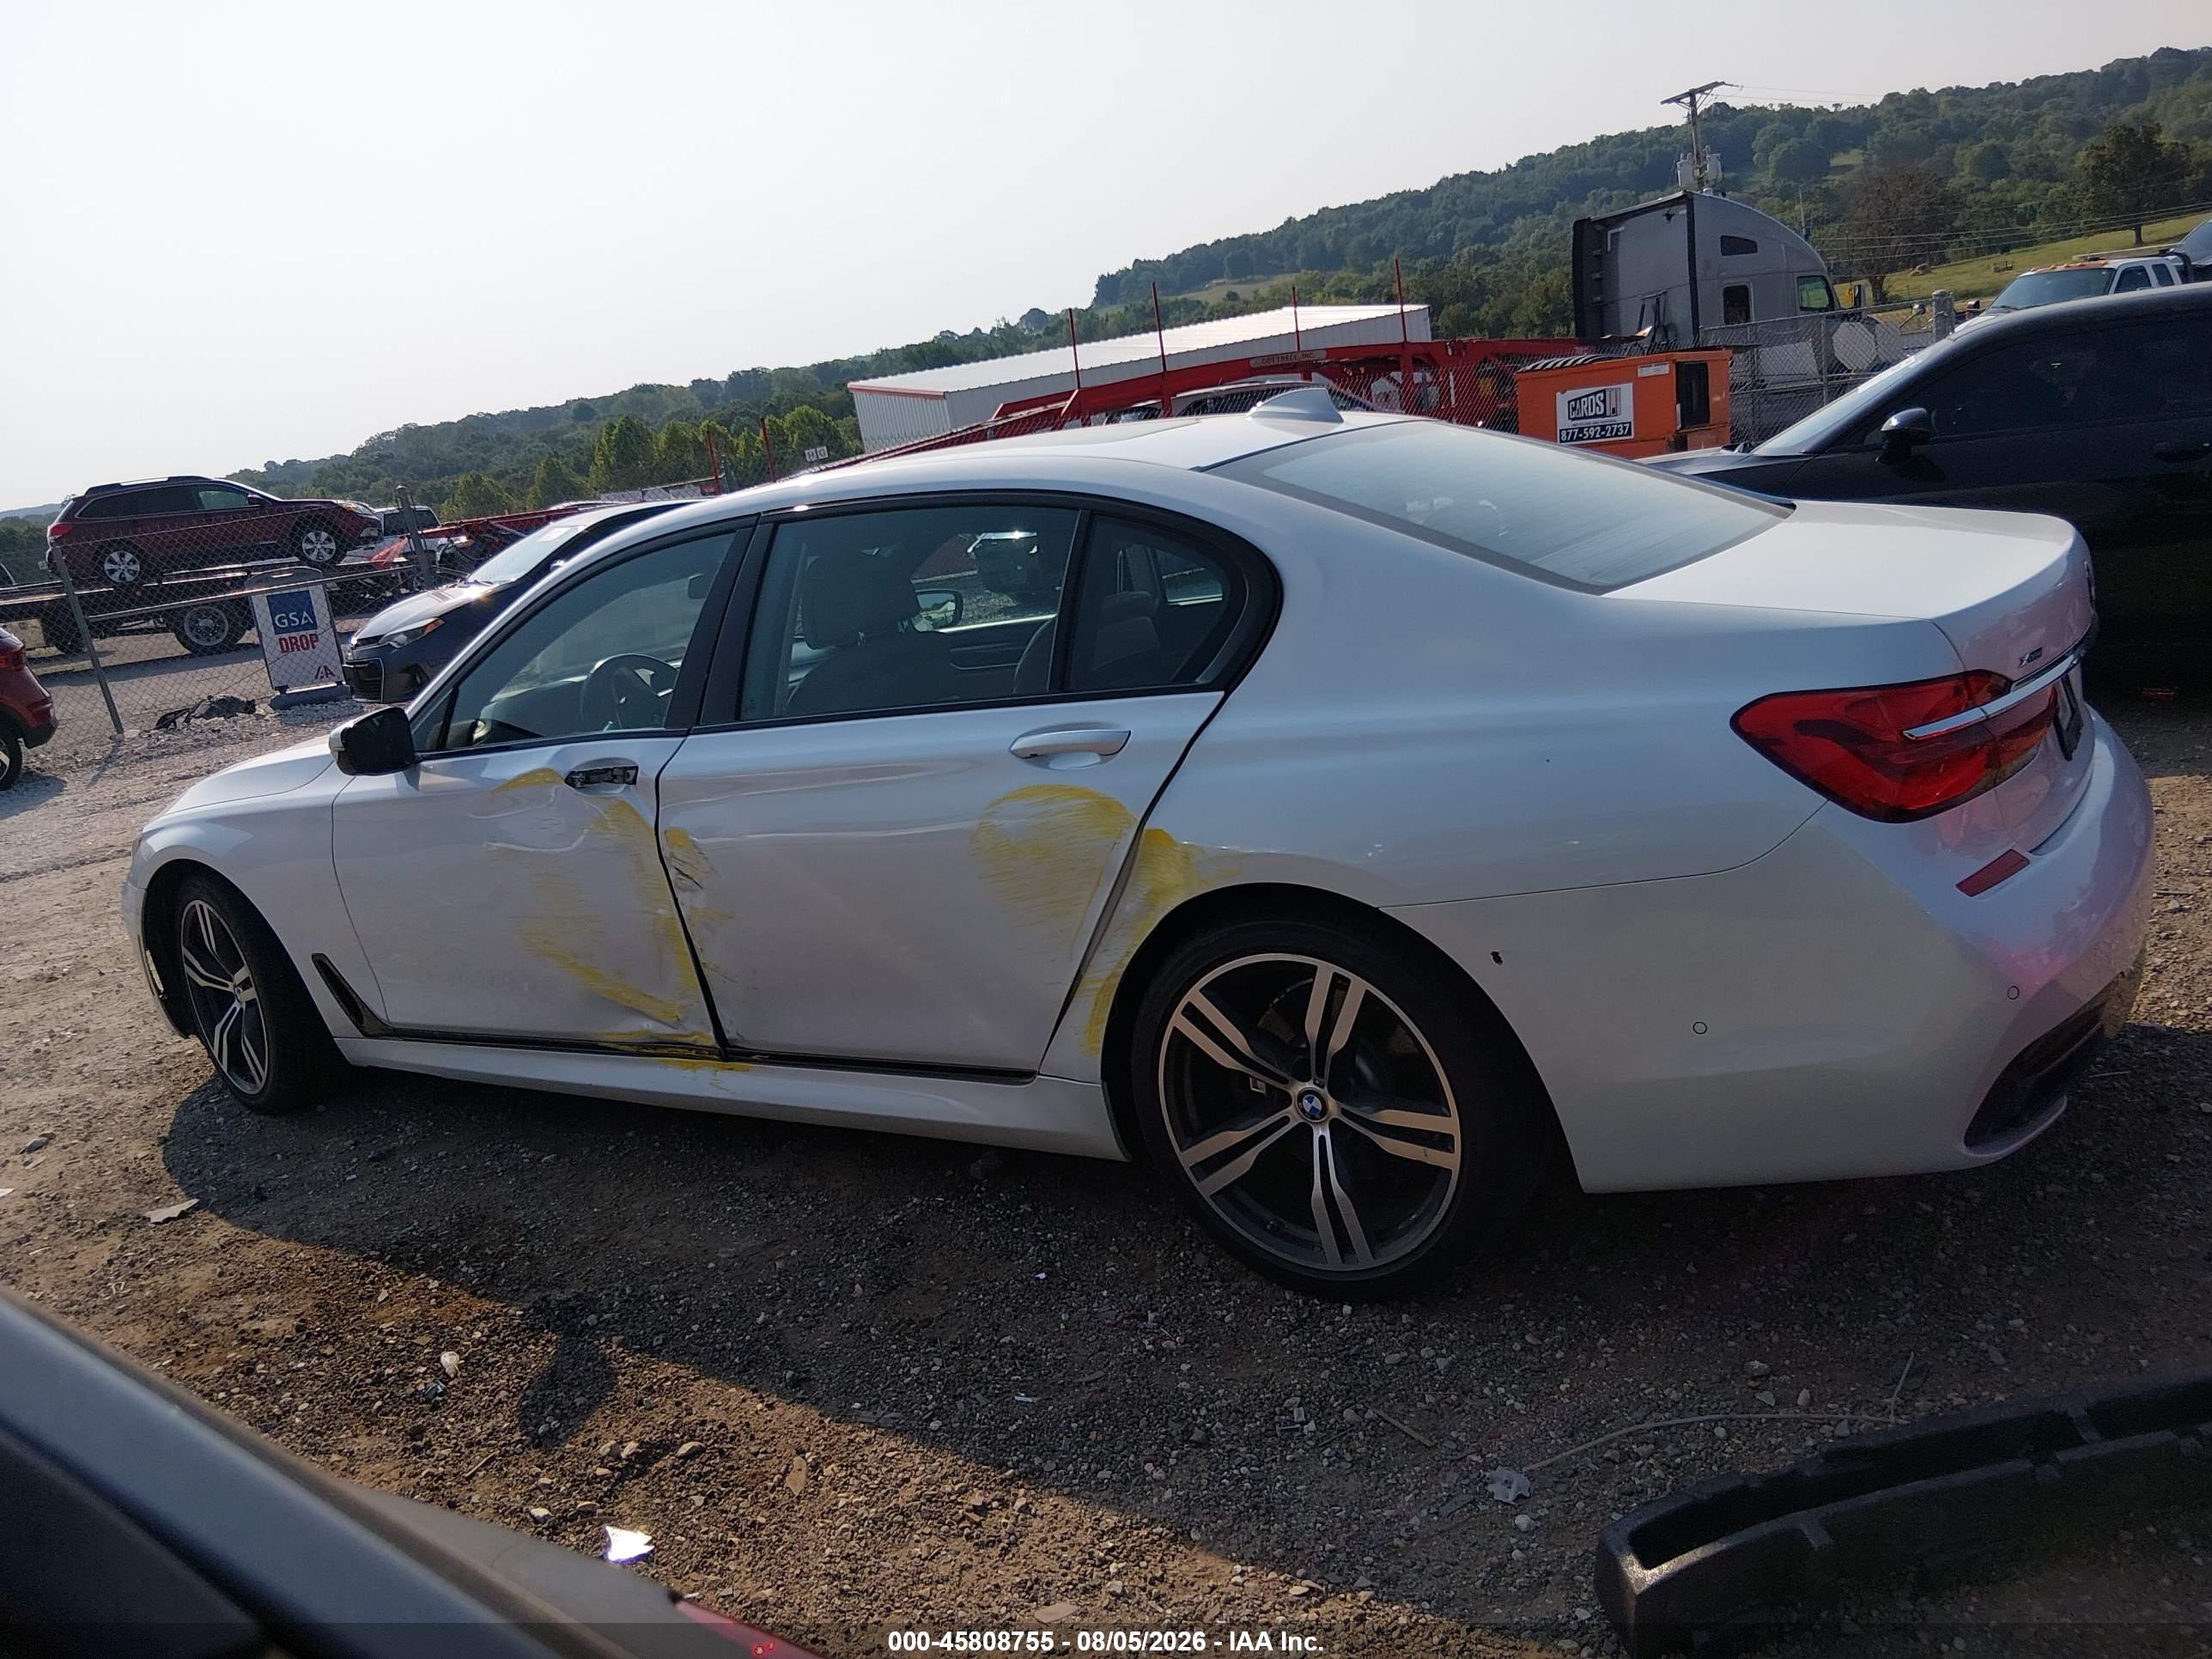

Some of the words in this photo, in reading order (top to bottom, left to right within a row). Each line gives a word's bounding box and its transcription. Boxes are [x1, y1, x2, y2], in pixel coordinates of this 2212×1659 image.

[1569, 392, 1605, 419] CARDS
[1560, 422, 1630, 441] 877-592-2737
[275, 611, 314, 629] GSA
[278, 633, 319, 653] DROP
